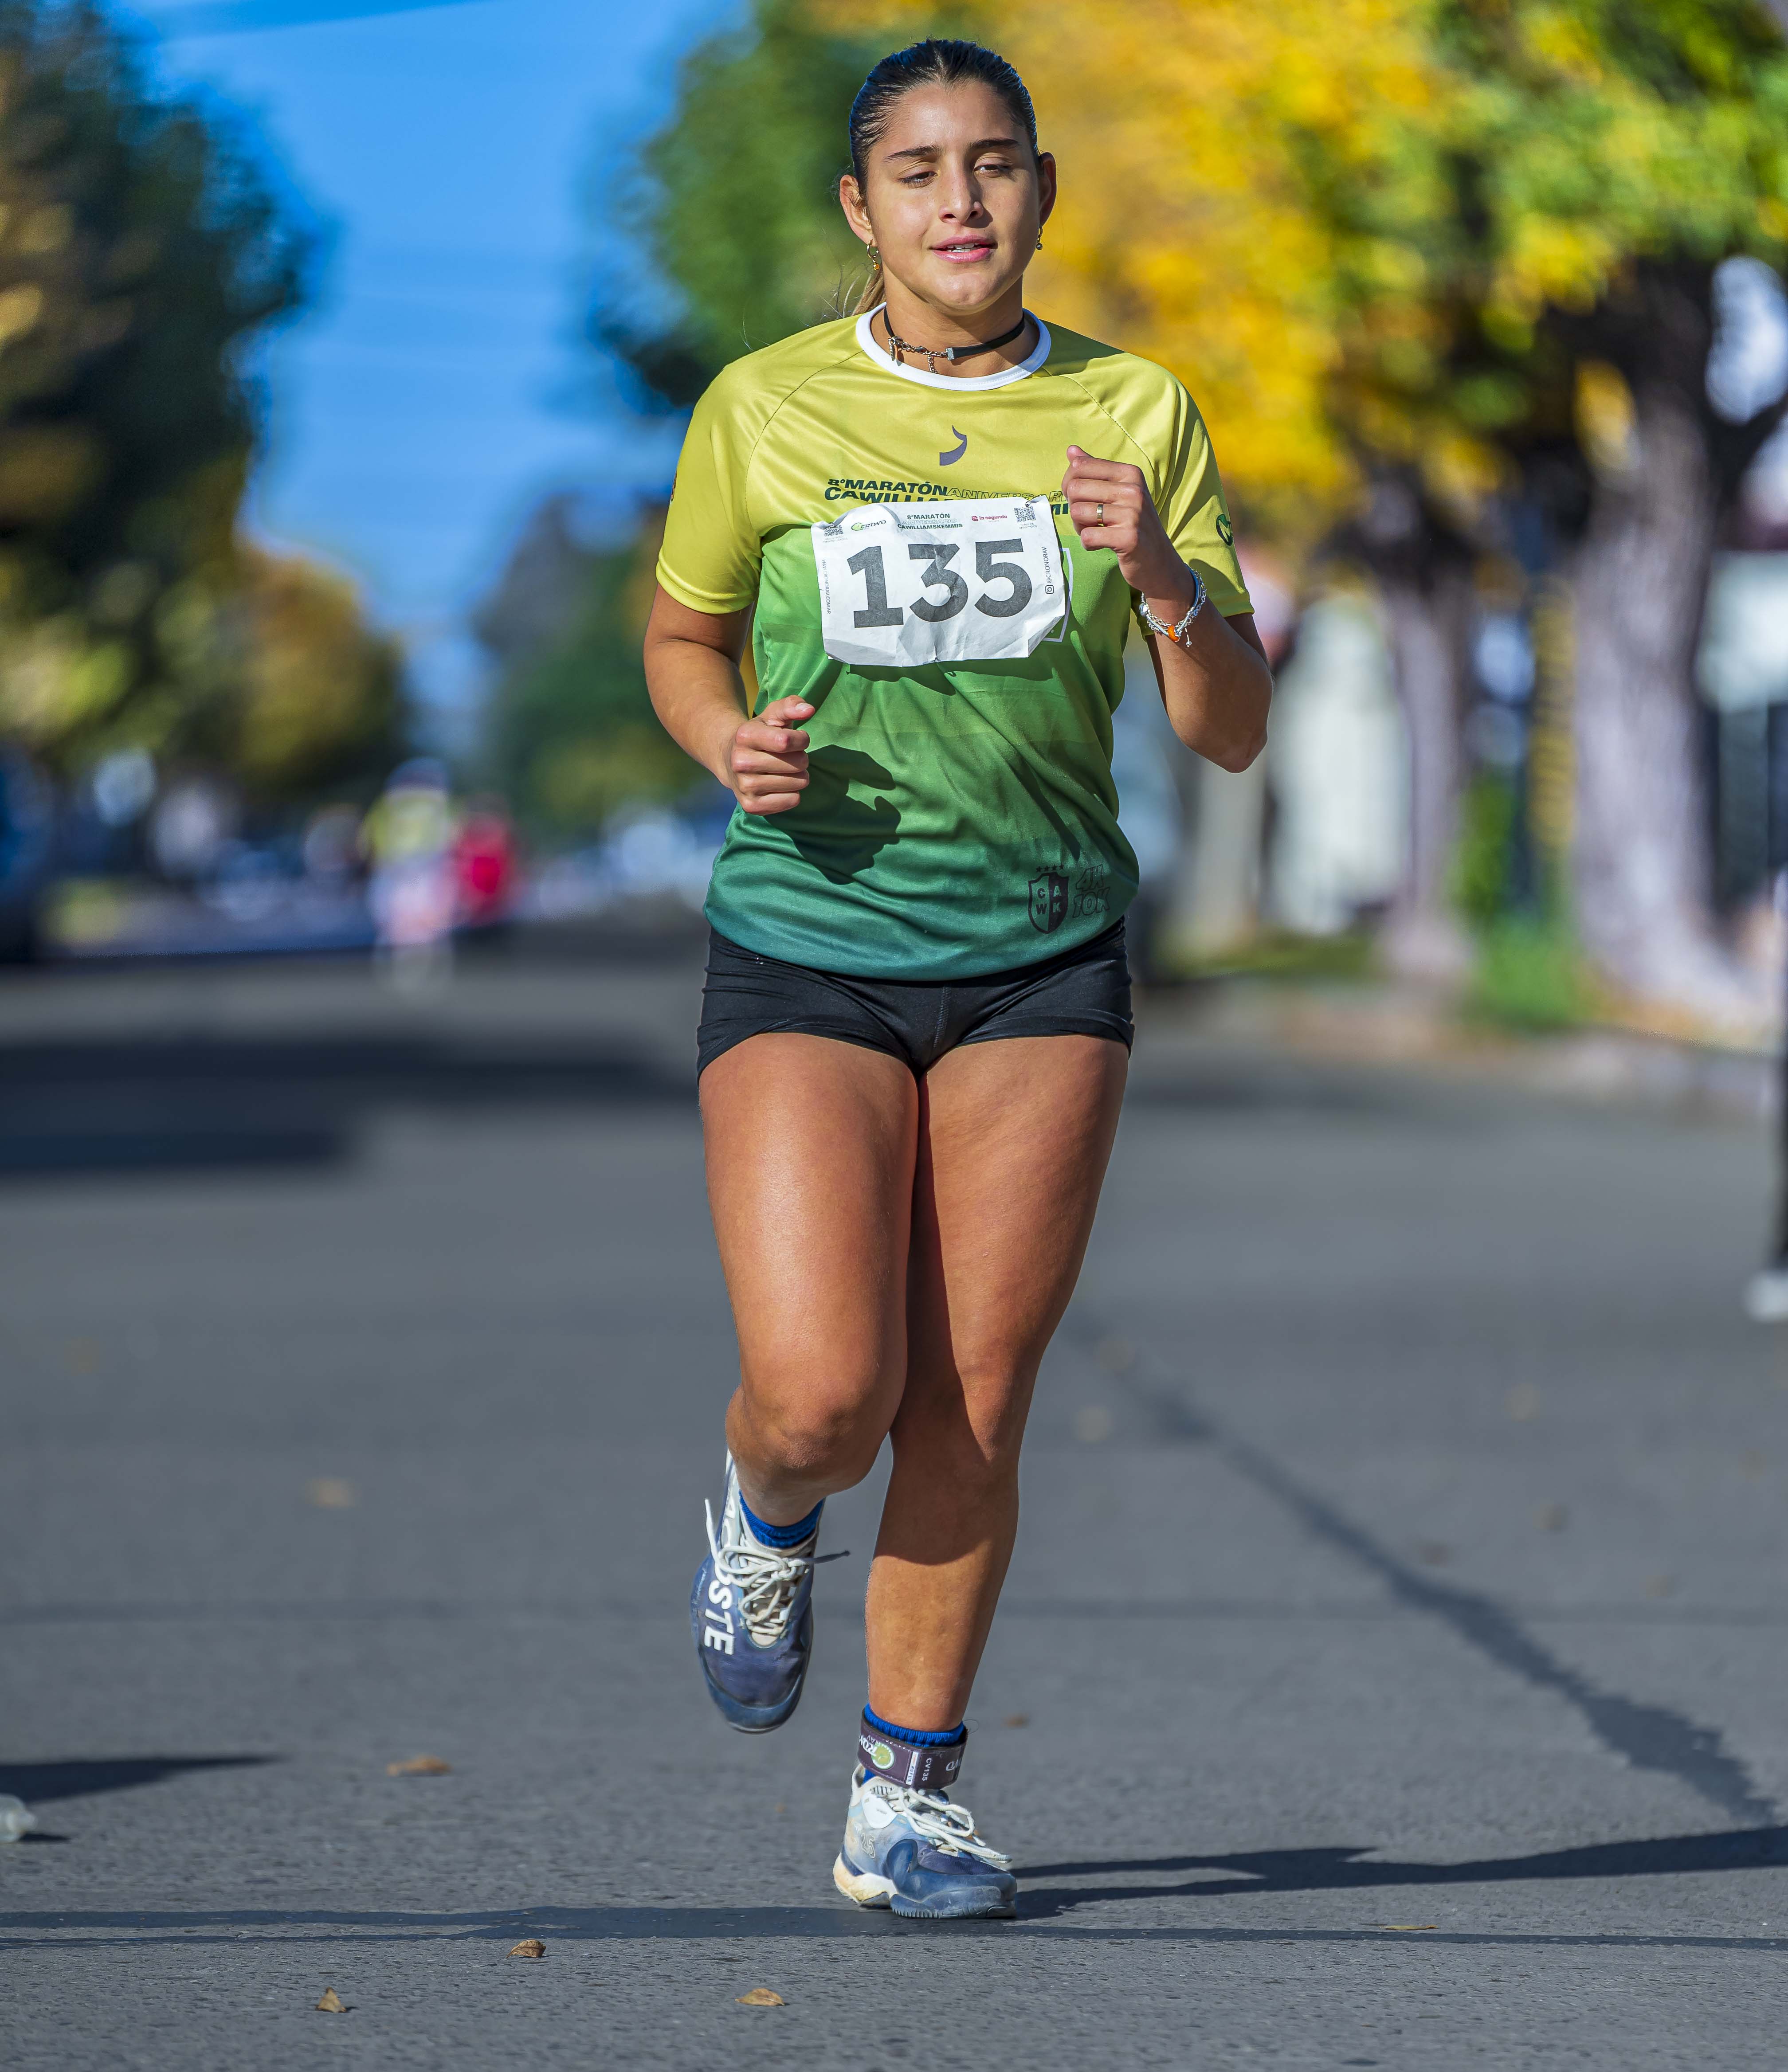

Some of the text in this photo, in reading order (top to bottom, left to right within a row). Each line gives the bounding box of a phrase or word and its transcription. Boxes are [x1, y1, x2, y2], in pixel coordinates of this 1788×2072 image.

[847, 538, 1032, 628] 135
[1042, 547, 1052, 583] @CRONORAV
[922, 1758, 932, 1782] CV135
